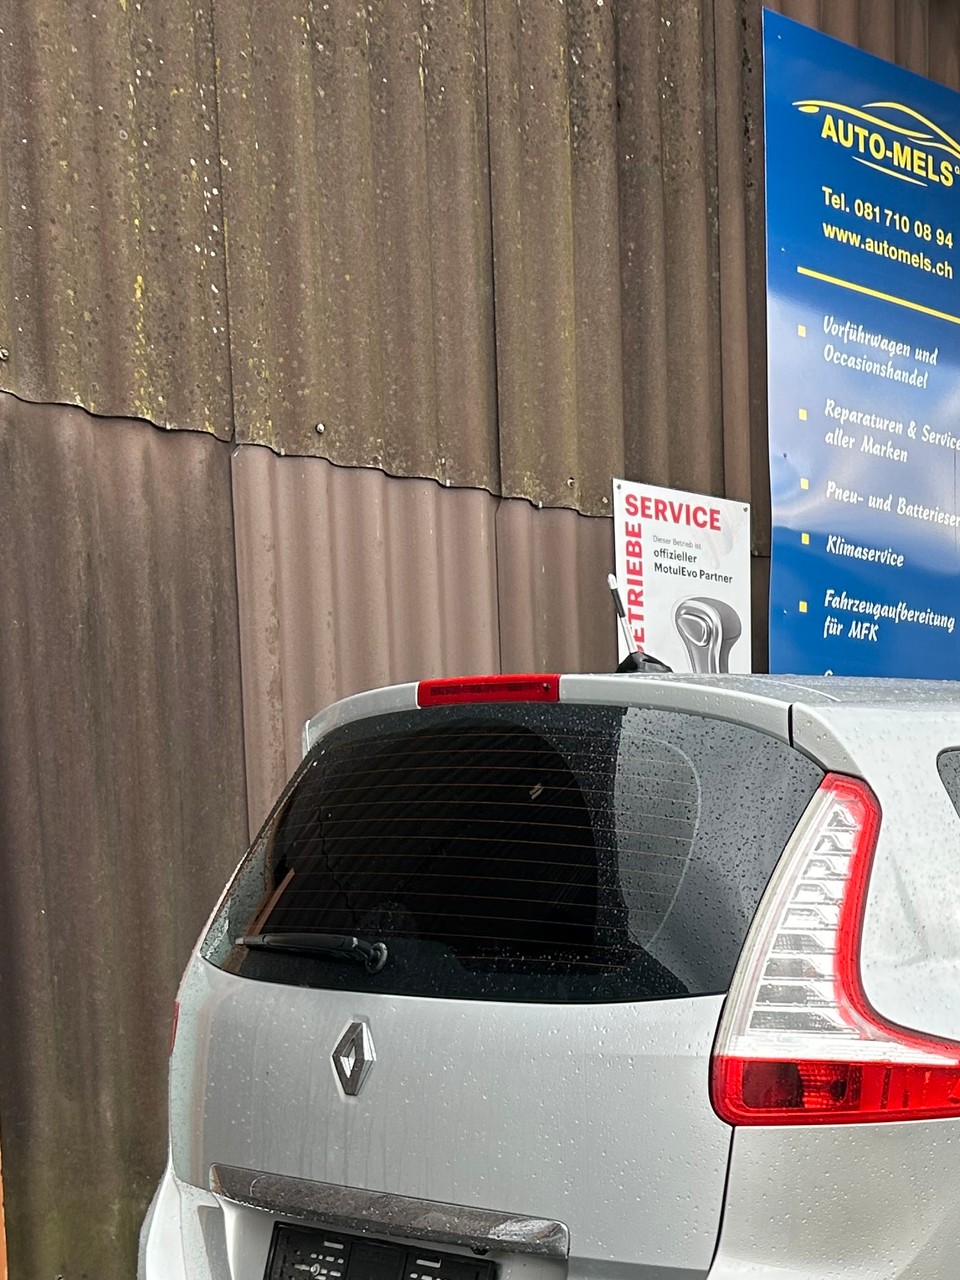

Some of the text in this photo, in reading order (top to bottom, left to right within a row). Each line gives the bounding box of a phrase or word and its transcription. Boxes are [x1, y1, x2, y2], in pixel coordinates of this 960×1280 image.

[821, 114, 954, 187] AUTO-MELS
[822, 186, 953, 249] Tel. 081 710 08 94
[822, 222, 953, 280] www.automels.ch
[823, 315, 939, 366] Vorführwagen und
[823, 343, 929, 389] Occasionshandel
[824, 398, 904, 435] Reparaturen
[907, 420, 917, 440] &
[824, 427, 908, 463] aller Marken
[625, 493, 721, 531] SERVICE
[826, 480, 864, 504] Pneu-
[868, 494, 892, 512] und
[652, 534, 671, 545] Dieser
[672, 538, 694, 548] Betrieb
[653, 547, 698, 563] offizieller
[826, 534, 904, 568] Klimaservice
[625, 521, 645, 653] ETRIEBE
[654, 562, 733, 584] MotulEvo Partner
[823, 615, 880, 642] für MFK
[824, 589, 956, 634] Fahrzeugaufbereitung
